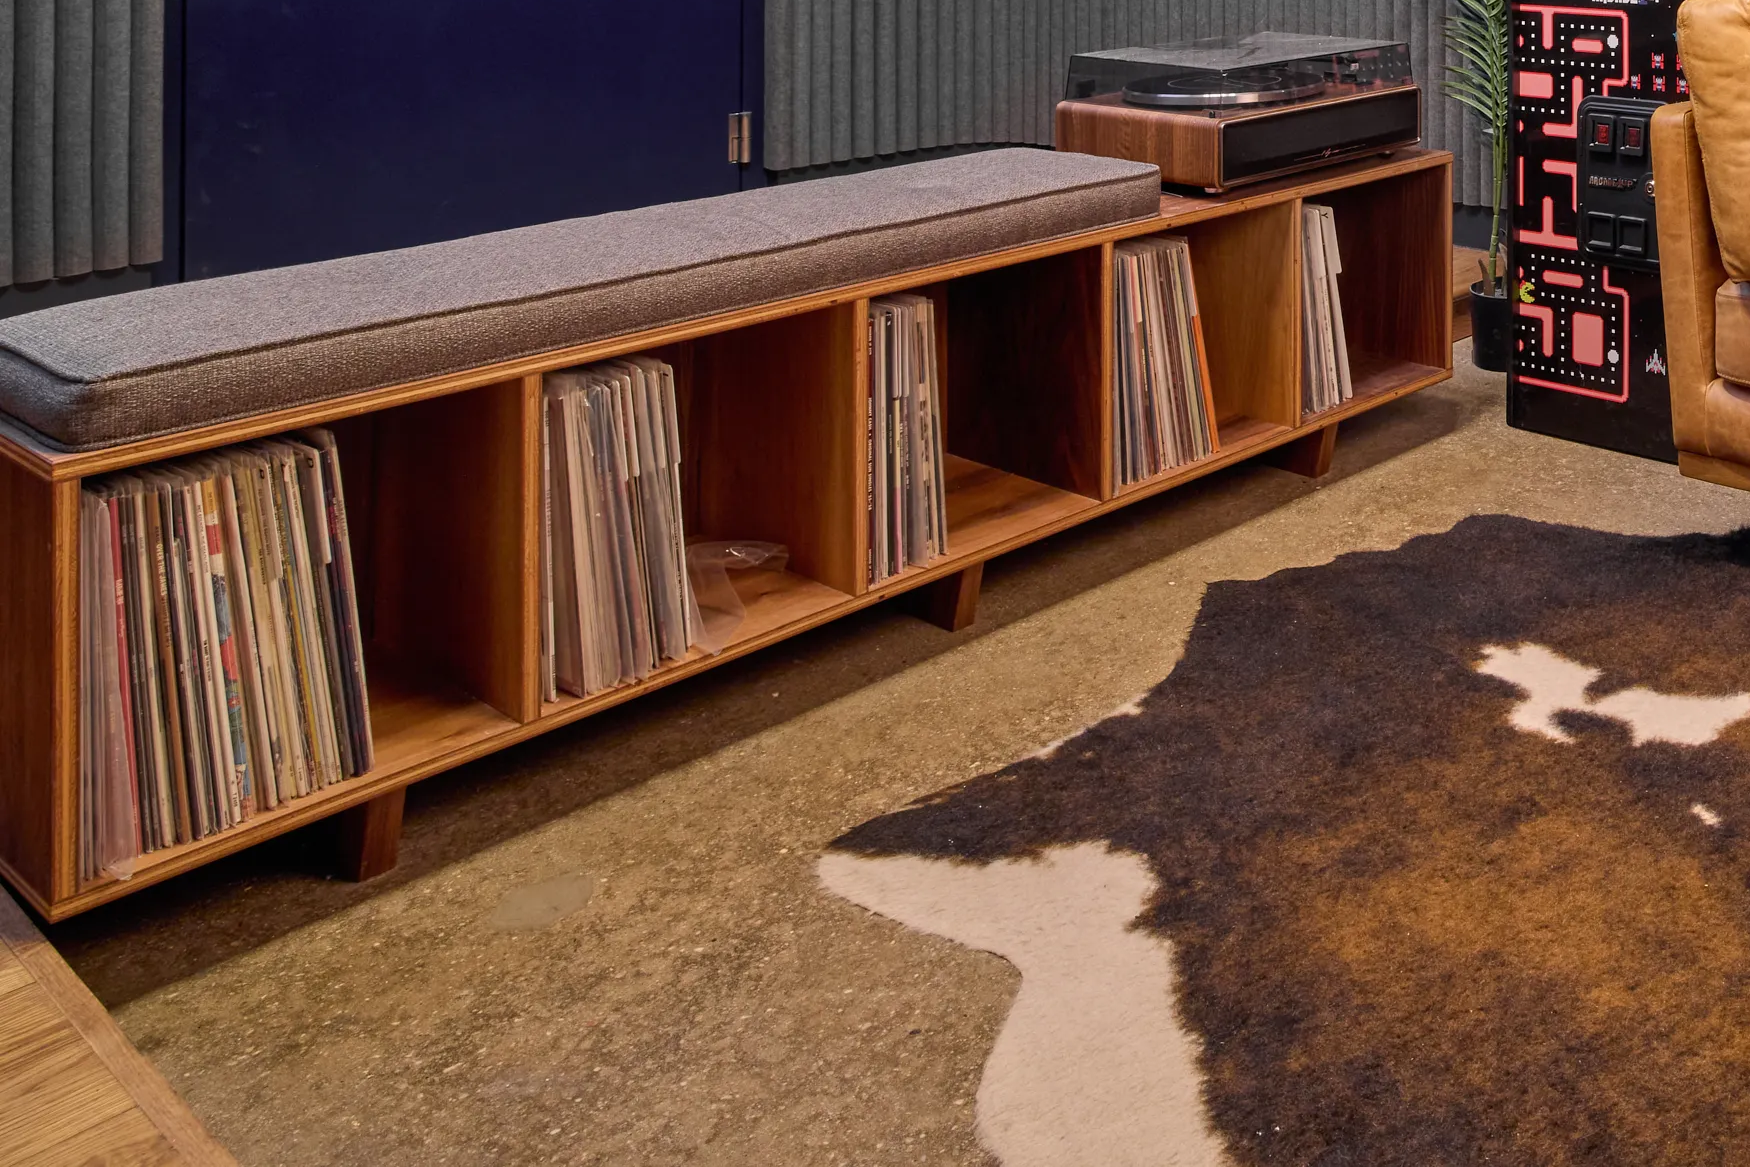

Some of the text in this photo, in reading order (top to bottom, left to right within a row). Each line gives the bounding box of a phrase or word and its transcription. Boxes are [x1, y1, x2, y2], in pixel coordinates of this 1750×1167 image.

[156, 543, 164, 561] OVER
[158, 561, 166, 574] THE
[159, 575, 168, 596] JAMES
